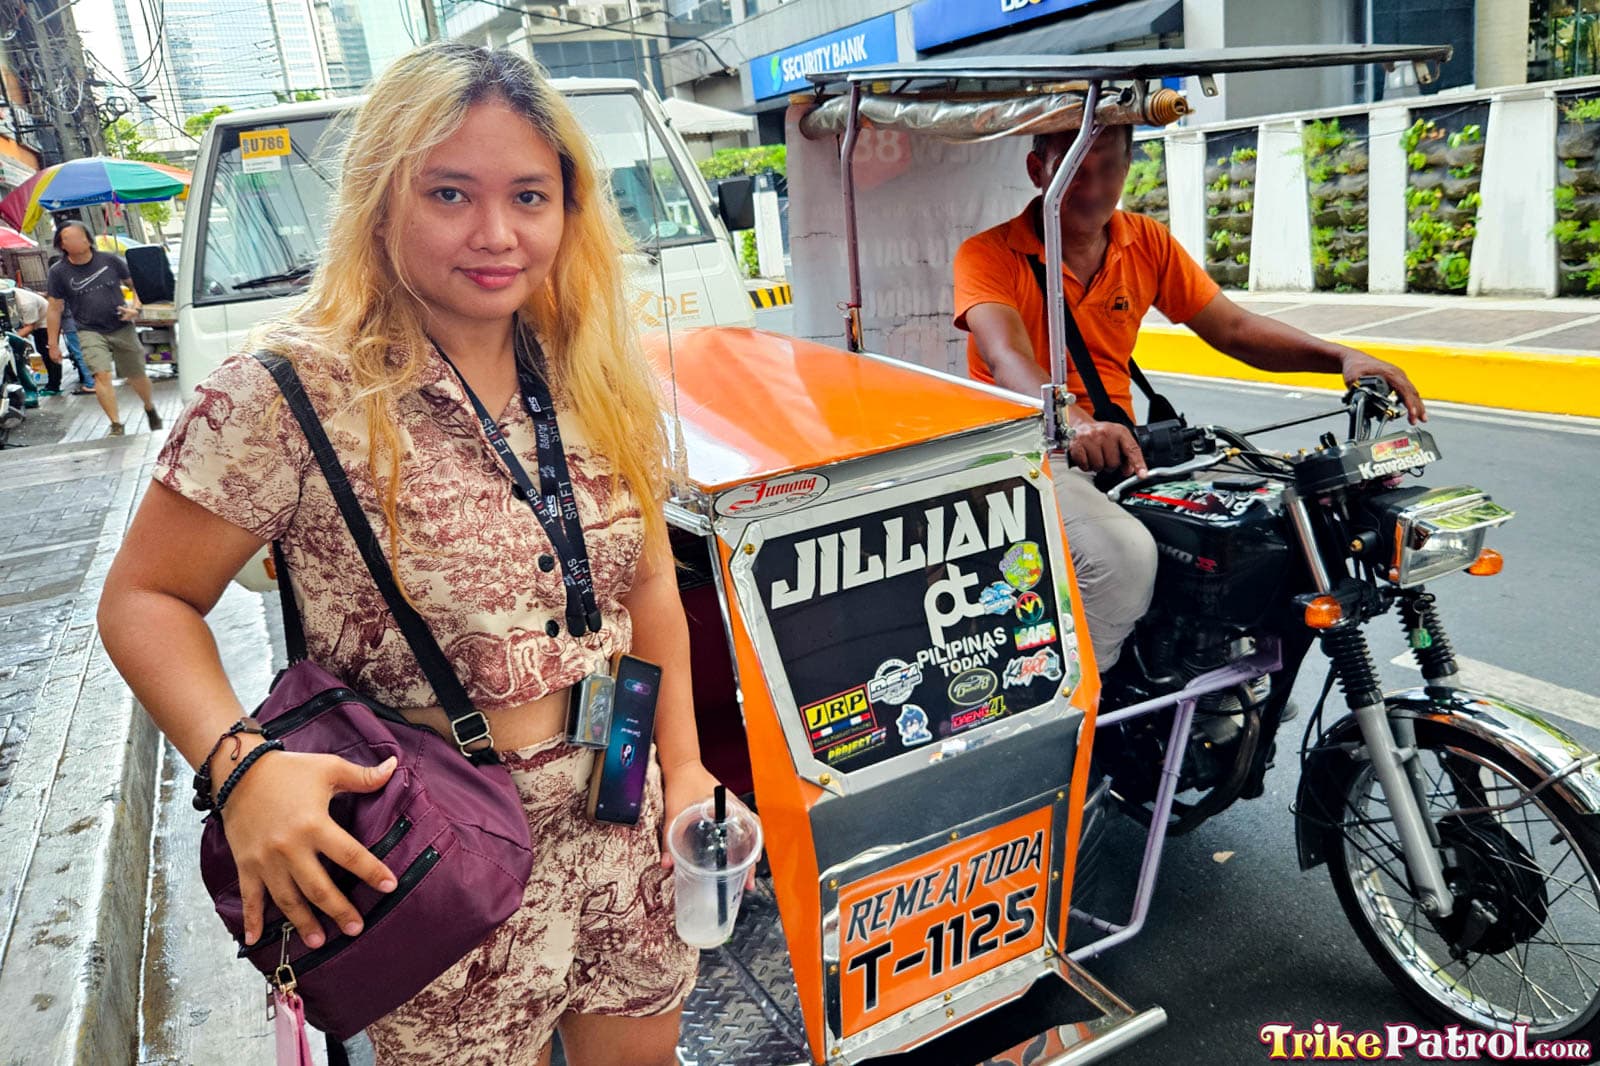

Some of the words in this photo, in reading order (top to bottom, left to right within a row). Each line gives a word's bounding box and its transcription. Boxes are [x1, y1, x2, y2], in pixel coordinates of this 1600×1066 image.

[783, 45, 831, 82] SECURITY
[832, 34, 868, 68] BANK
[771, 486, 1026, 610] JILLIAN
[916, 626, 1008, 669] PILIPINAS
[939, 650, 993, 678] TODAY
[811, 693, 863, 727] JRP
[846, 883, 1039, 1013] T-1125
